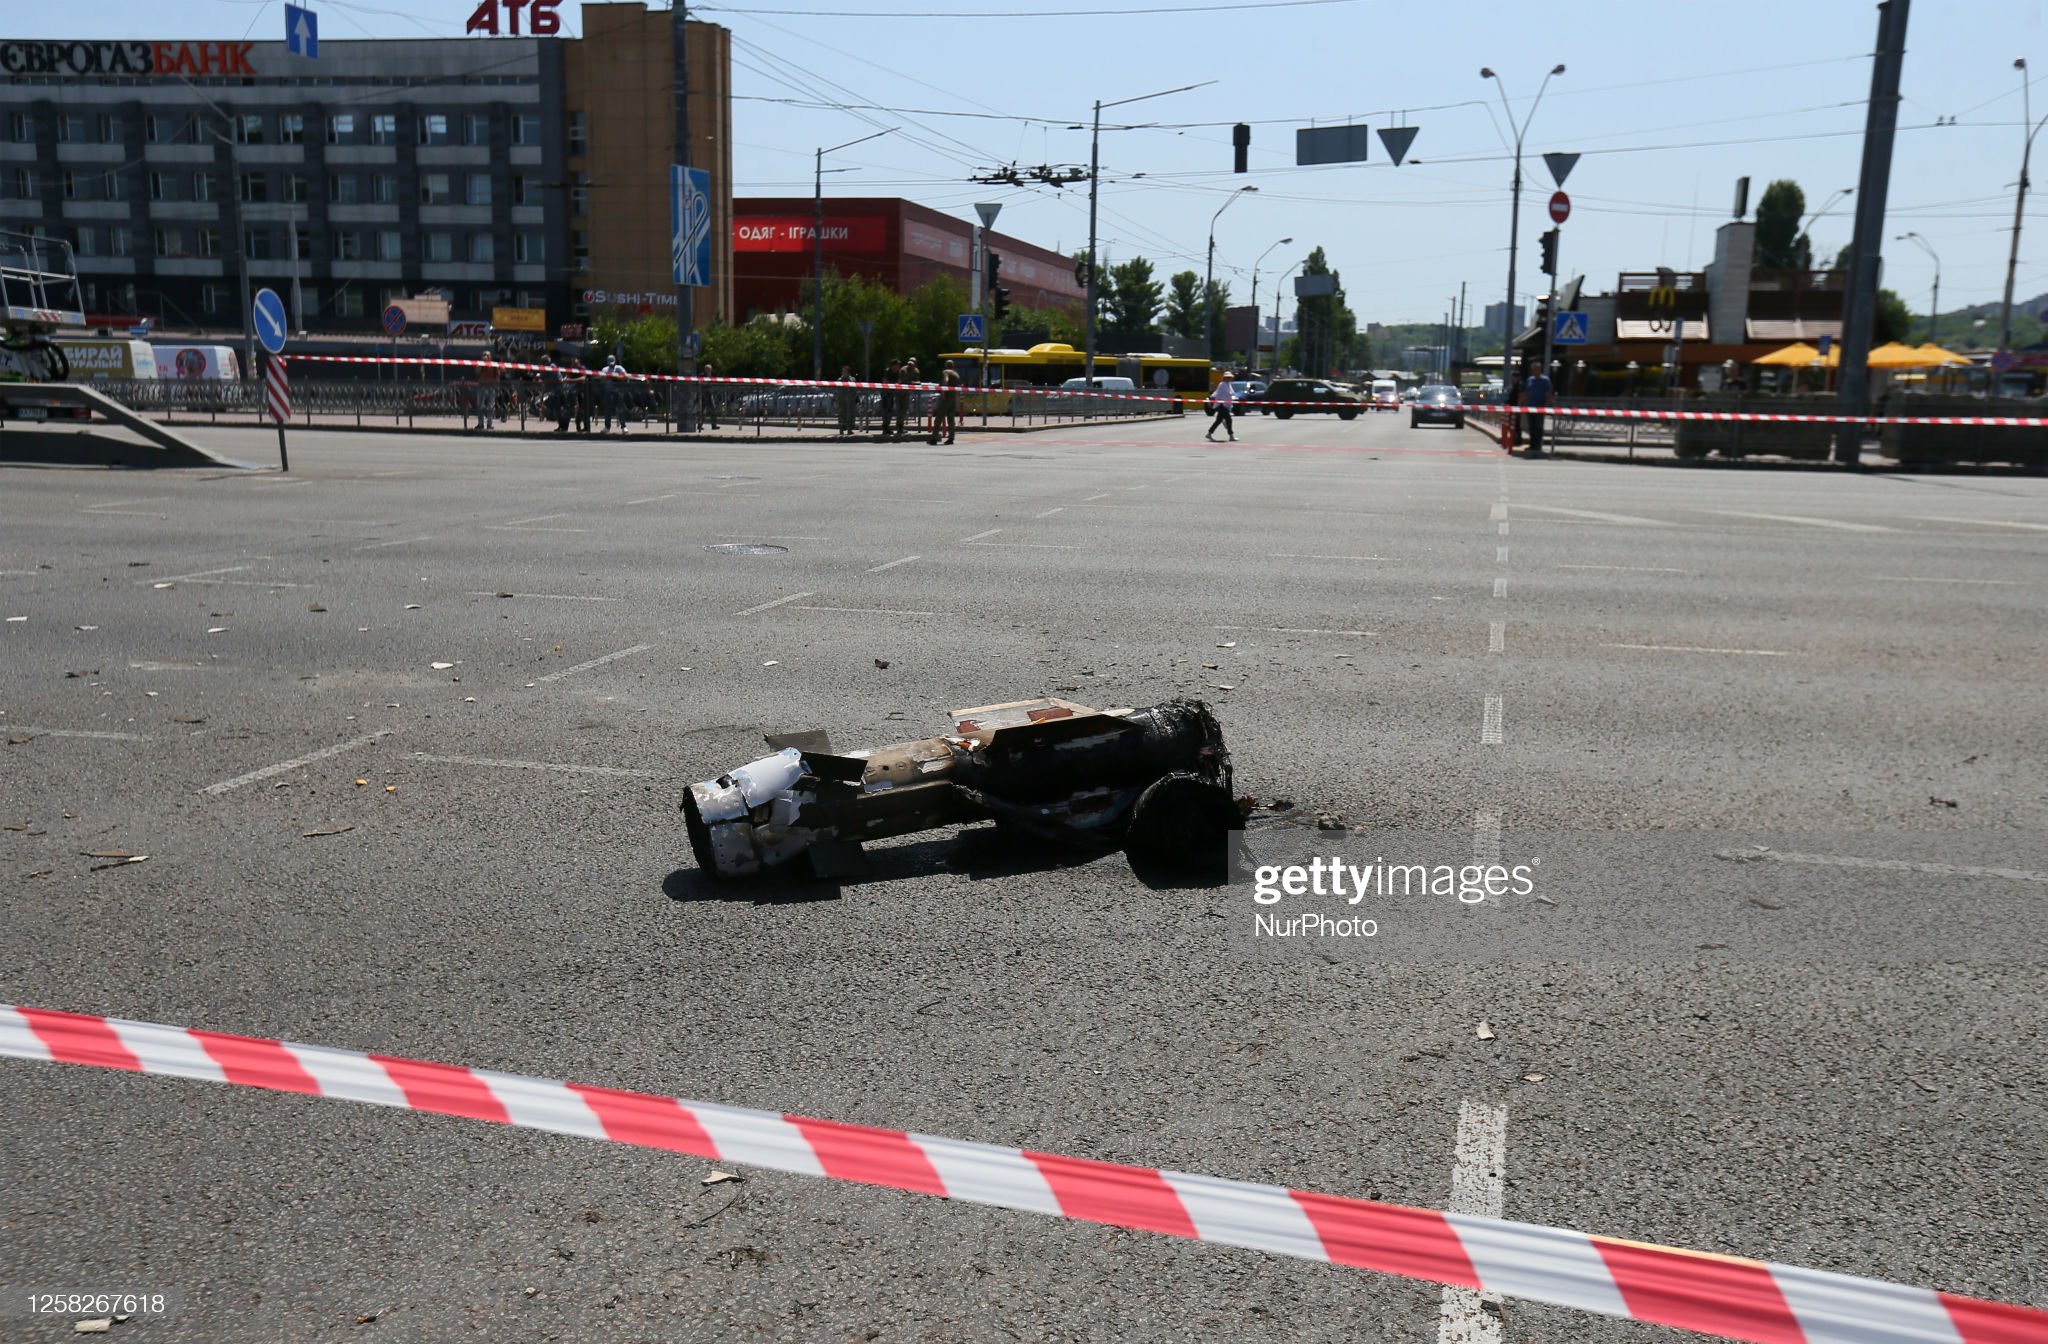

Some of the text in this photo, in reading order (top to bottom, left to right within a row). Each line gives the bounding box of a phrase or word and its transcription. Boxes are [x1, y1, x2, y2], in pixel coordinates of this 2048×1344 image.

[466, 0, 563, 35] АТБ
[1, 42, 256, 75] ЄВРОГАЗБАНК
[739, 226, 776, 240] ОДЯГ
[788, 226, 848, 239] ІГРАШКИ
